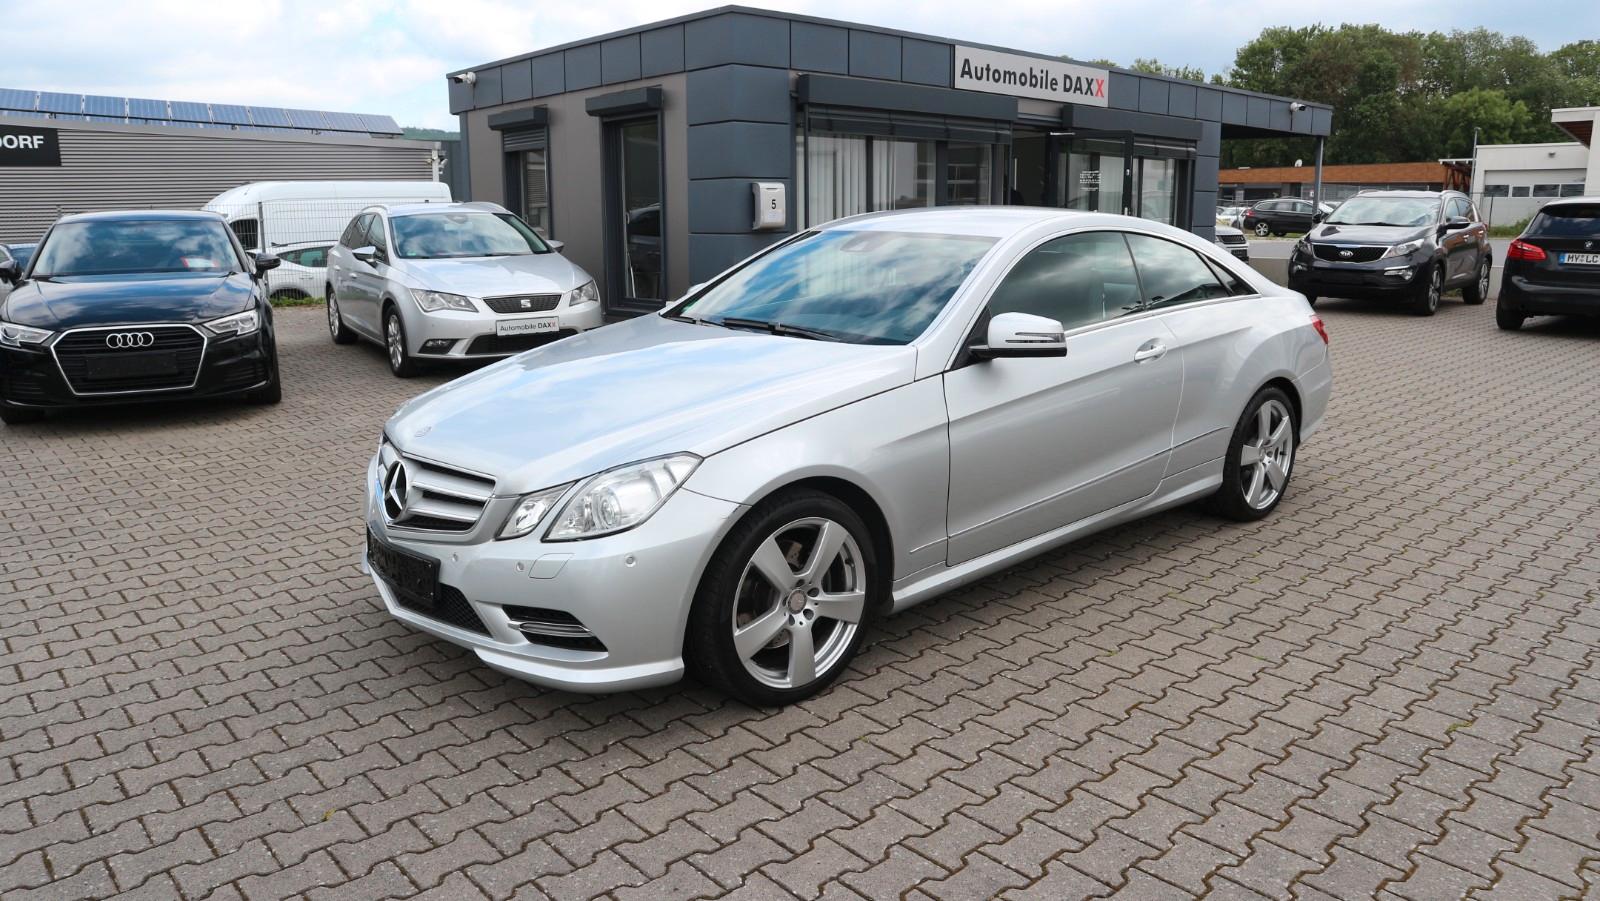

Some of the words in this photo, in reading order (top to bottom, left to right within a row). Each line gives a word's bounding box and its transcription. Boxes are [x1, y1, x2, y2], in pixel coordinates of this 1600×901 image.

[960, 58, 1059, 92] Automobile
[1063, 73, 1105, 98] DAXX
[0, 134, 44, 149] ORF
[771, 198, 777, 210] 5
[500, 323, 537, 332] Automobile
[537, 320, 556, 330] DAXX
